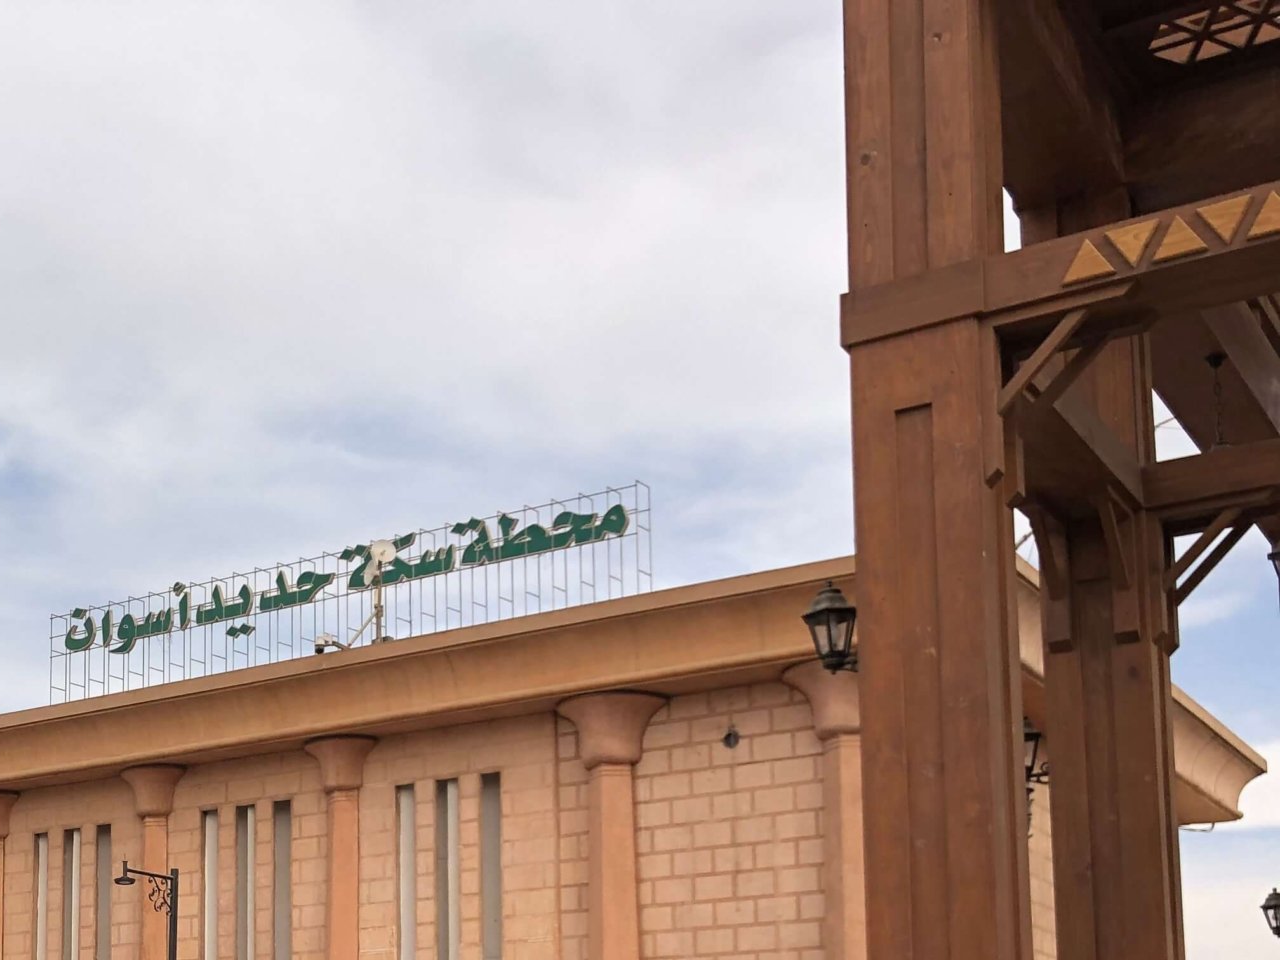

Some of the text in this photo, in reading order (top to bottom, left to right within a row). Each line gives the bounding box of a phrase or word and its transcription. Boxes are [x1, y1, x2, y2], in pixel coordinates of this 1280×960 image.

[64, 503, 630, 655] محطة سكة حديد أسوان
